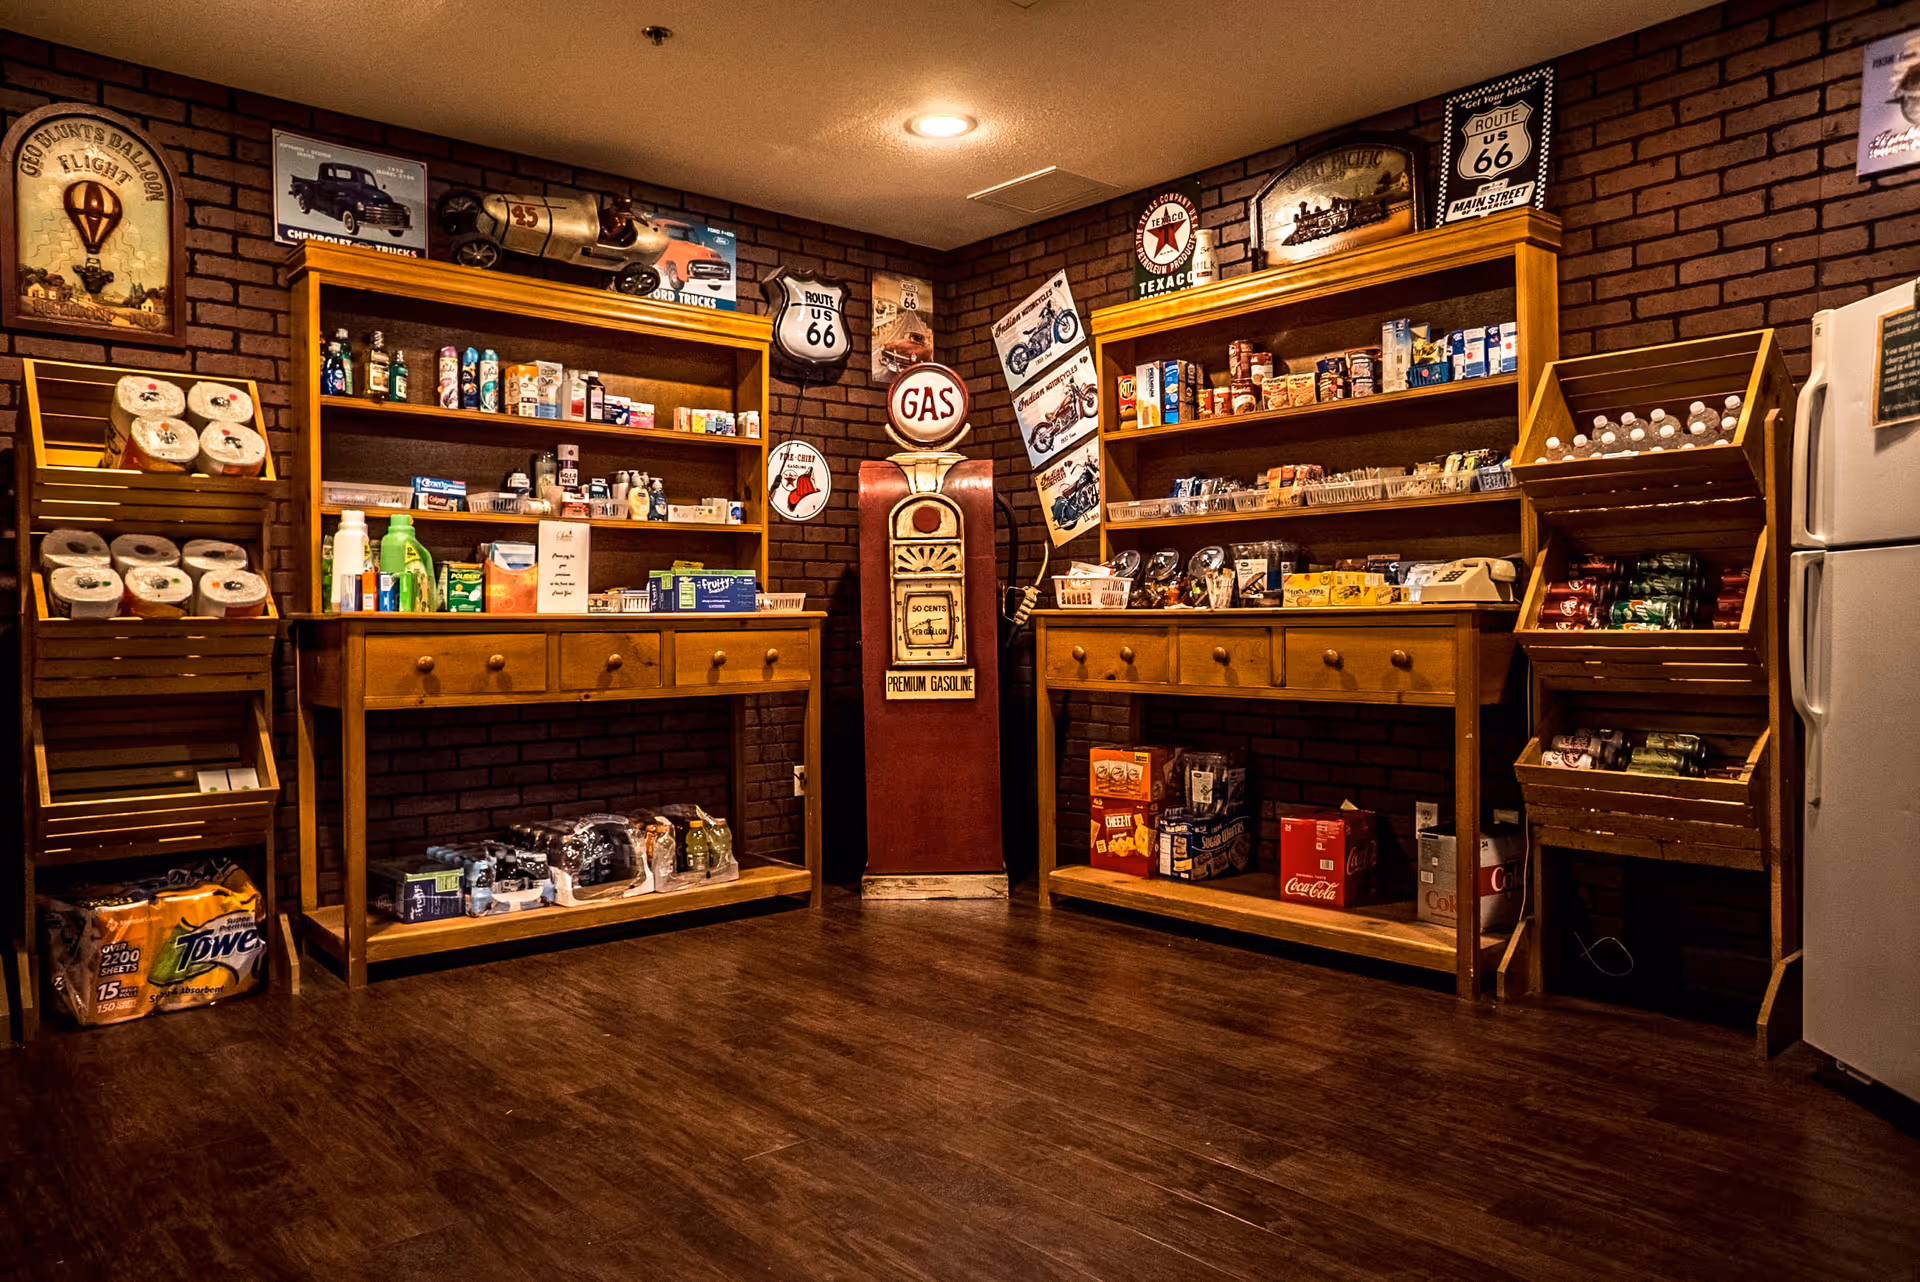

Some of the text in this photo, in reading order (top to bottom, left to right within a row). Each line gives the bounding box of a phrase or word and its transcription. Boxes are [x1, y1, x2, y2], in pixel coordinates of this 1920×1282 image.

[1484, 92, 1505, 104] Your
[1476, 109, 1519, 132] ROUTE
[1483, 130, 1508, 145] US
[20, 123, 164, 202] GEO BLUNTS BALLOON
[1331, 150, 1384, 170] PACIFIC
[1474, 143, 1513, 174] 66
[57, 154, 134, 186] FLIGHT
[1140, 200, 1158, 225] TEXAS
[1160, 193, 1191, 208] COMPANY
[1452, 196, 1486, 213] MAIN
[1487, 185, 1529, 204] STREET
[1475, 200, 1514, 212] AMERICA
[1152, 212, 1183, 227] TEXACO
[287, 229, 417, 258] CHEVROLET TRUCKS
[1136, 233, 1197, 274] PETROLEUM PRODUCTS
[1139, 270, 1193, 294] TEXACO
[678, 292, 717, 309] TRUCKS
[805, 290, 834, 308] ROUTE
[904, 298, 916, 309] 66
[811, 308, 832, 321] US
[995, 289, 1053, 338] Indian MOTORCYCLES
[806, 322, 835, 348] 66
[1885, 364, 1897, 374] and
[1018, 365, 1078, 411] Indian MOTORCYCLES
[901, 386, 954, 421] GAS
[1040, 467, 1064, 486] Indian
[888, 675, 973, 692] PREMIUM GASOLINE
[1105, 816, 1132, 828] CHEEZ-IT
[1202, 822, 1244, 849] SUGAR WAFERS
[1285, 877, 1340, 900] Coca-Cola
[1425, 890, 1456, 912] Cok
[102, 943, 126, 953] OVER
[102, 950, 140, 966] 2200
[176, 929, 259, 972] Towe
[101, 964, 137, 976] SHEETS
[98, 982, 120, 1000] 15
[97, 1002, 115, 1013] 150
